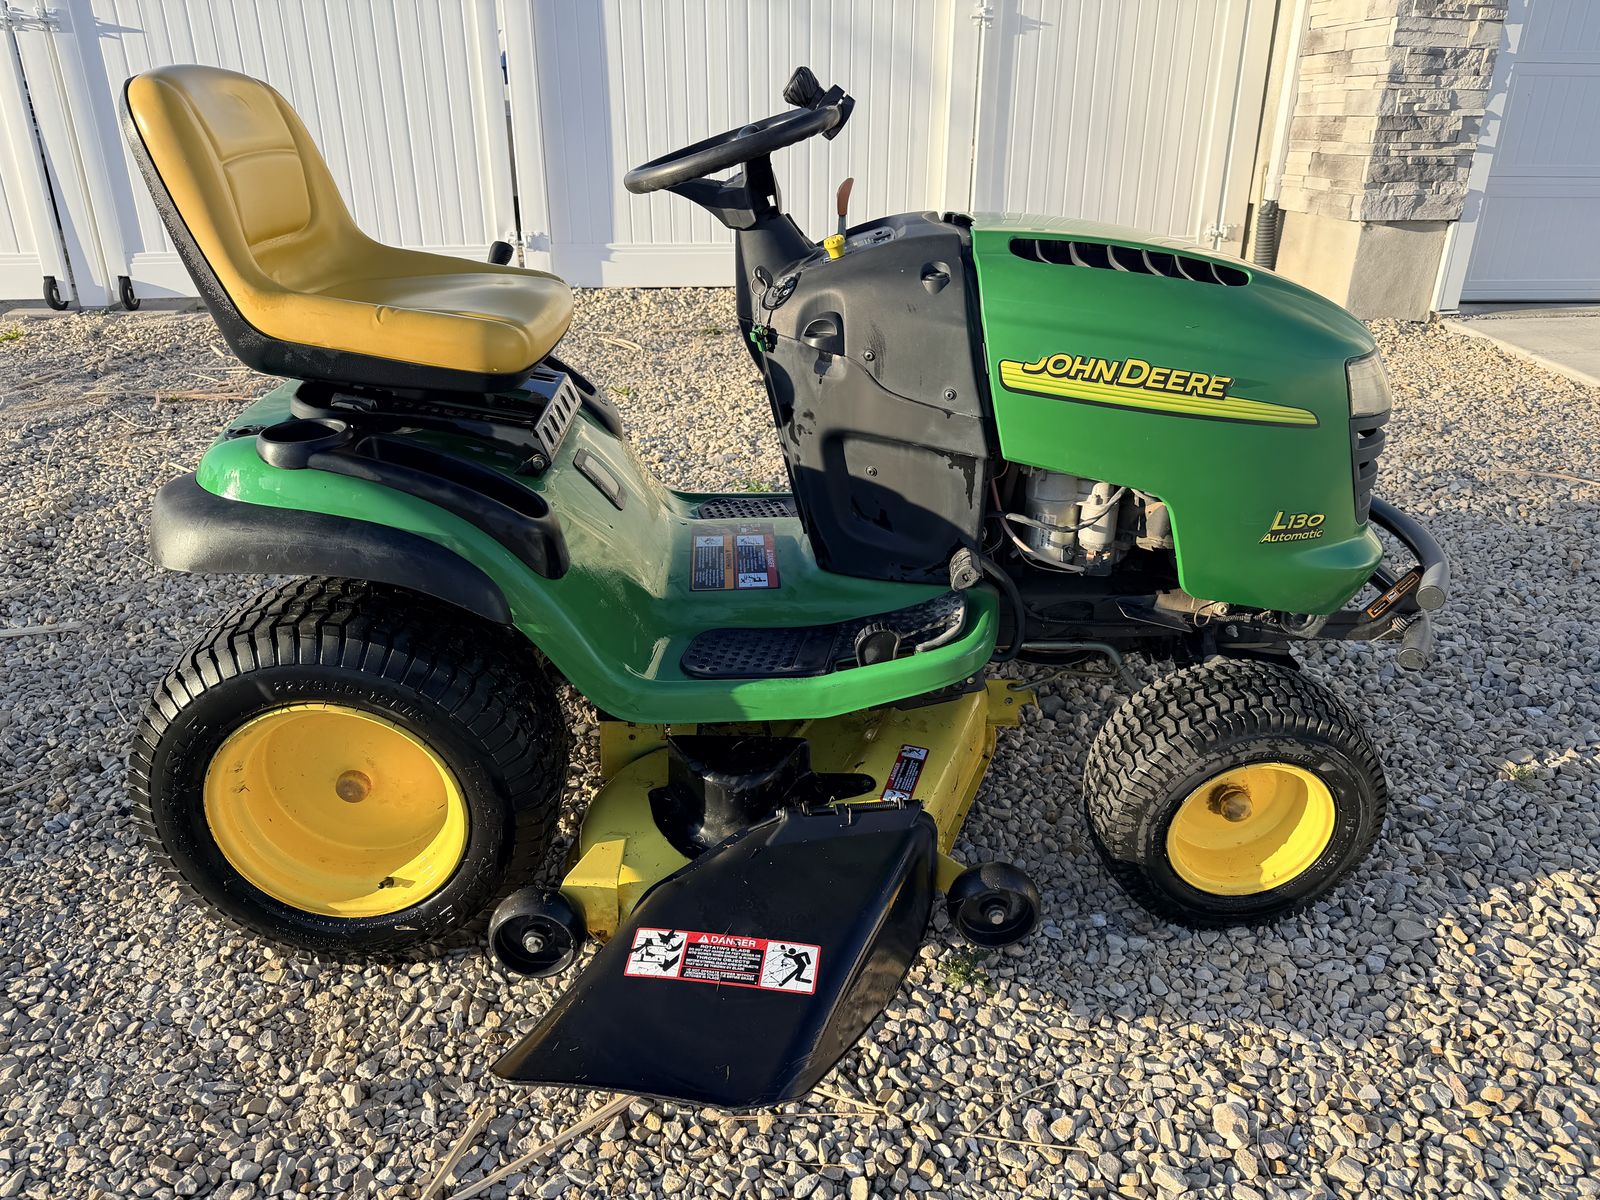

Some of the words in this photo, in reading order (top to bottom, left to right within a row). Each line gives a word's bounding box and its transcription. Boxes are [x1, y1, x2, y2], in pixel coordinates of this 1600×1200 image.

[1023, 353, 1118, 383] JOHN
[1118, 358, 1233, 399] DEERE
[1271, 511, 1325, 530] L130
[1260, 529, 1323, 543] Automatic
[710, 936, 756, 947] DANGER
